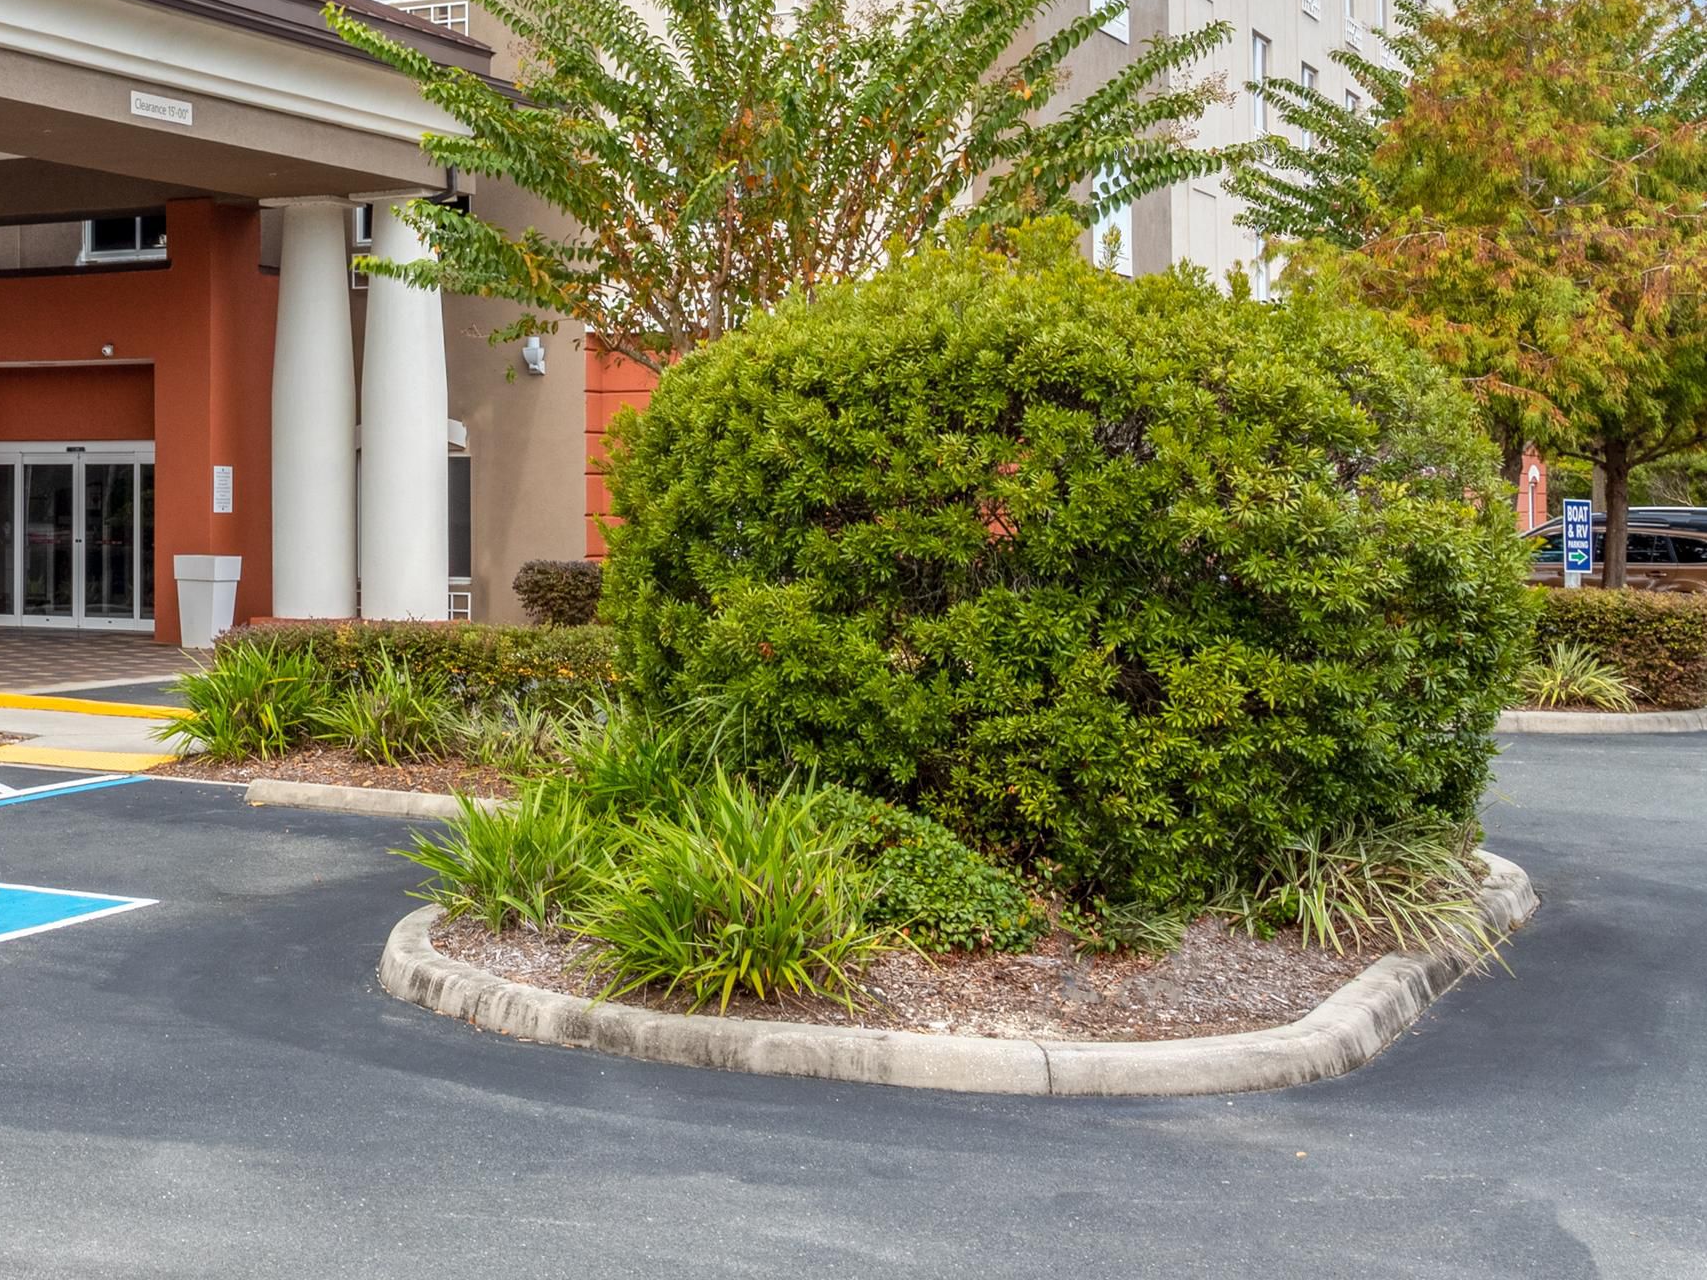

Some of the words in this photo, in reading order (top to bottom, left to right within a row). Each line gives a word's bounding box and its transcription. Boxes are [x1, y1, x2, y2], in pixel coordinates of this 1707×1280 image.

[135, 98, 167, 115] Clearance
[1566, 505, 1589, 522] BOAT
[1567, 523, 1575, 538] &
[1576, 524, 1589, 539] RV
[1567, 540, 1589, 549] PARKING
